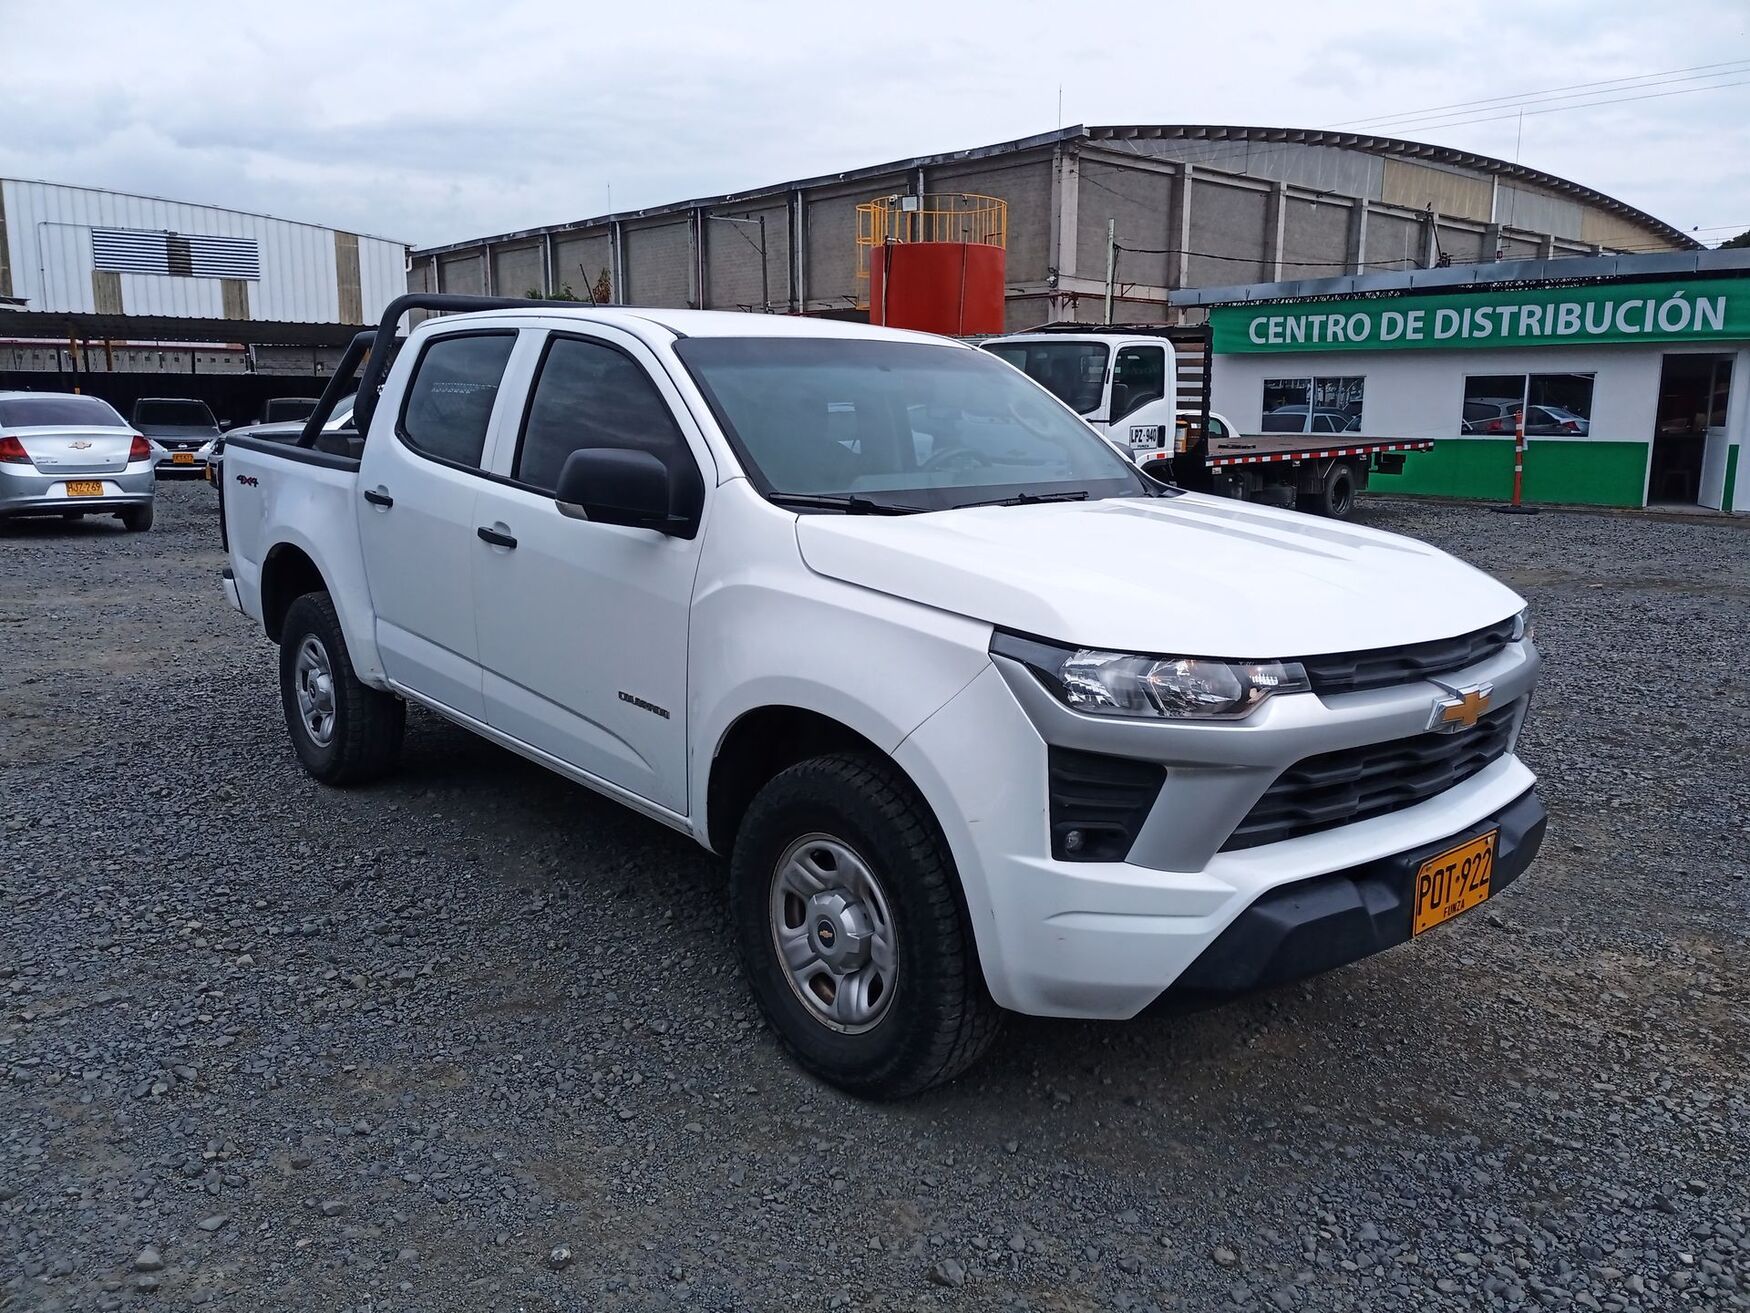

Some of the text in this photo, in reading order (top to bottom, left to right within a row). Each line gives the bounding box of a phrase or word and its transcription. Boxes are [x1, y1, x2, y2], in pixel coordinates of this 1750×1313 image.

[1249, 290, 1727, 344] CENTRO DE DISTRIBUCIÓN
